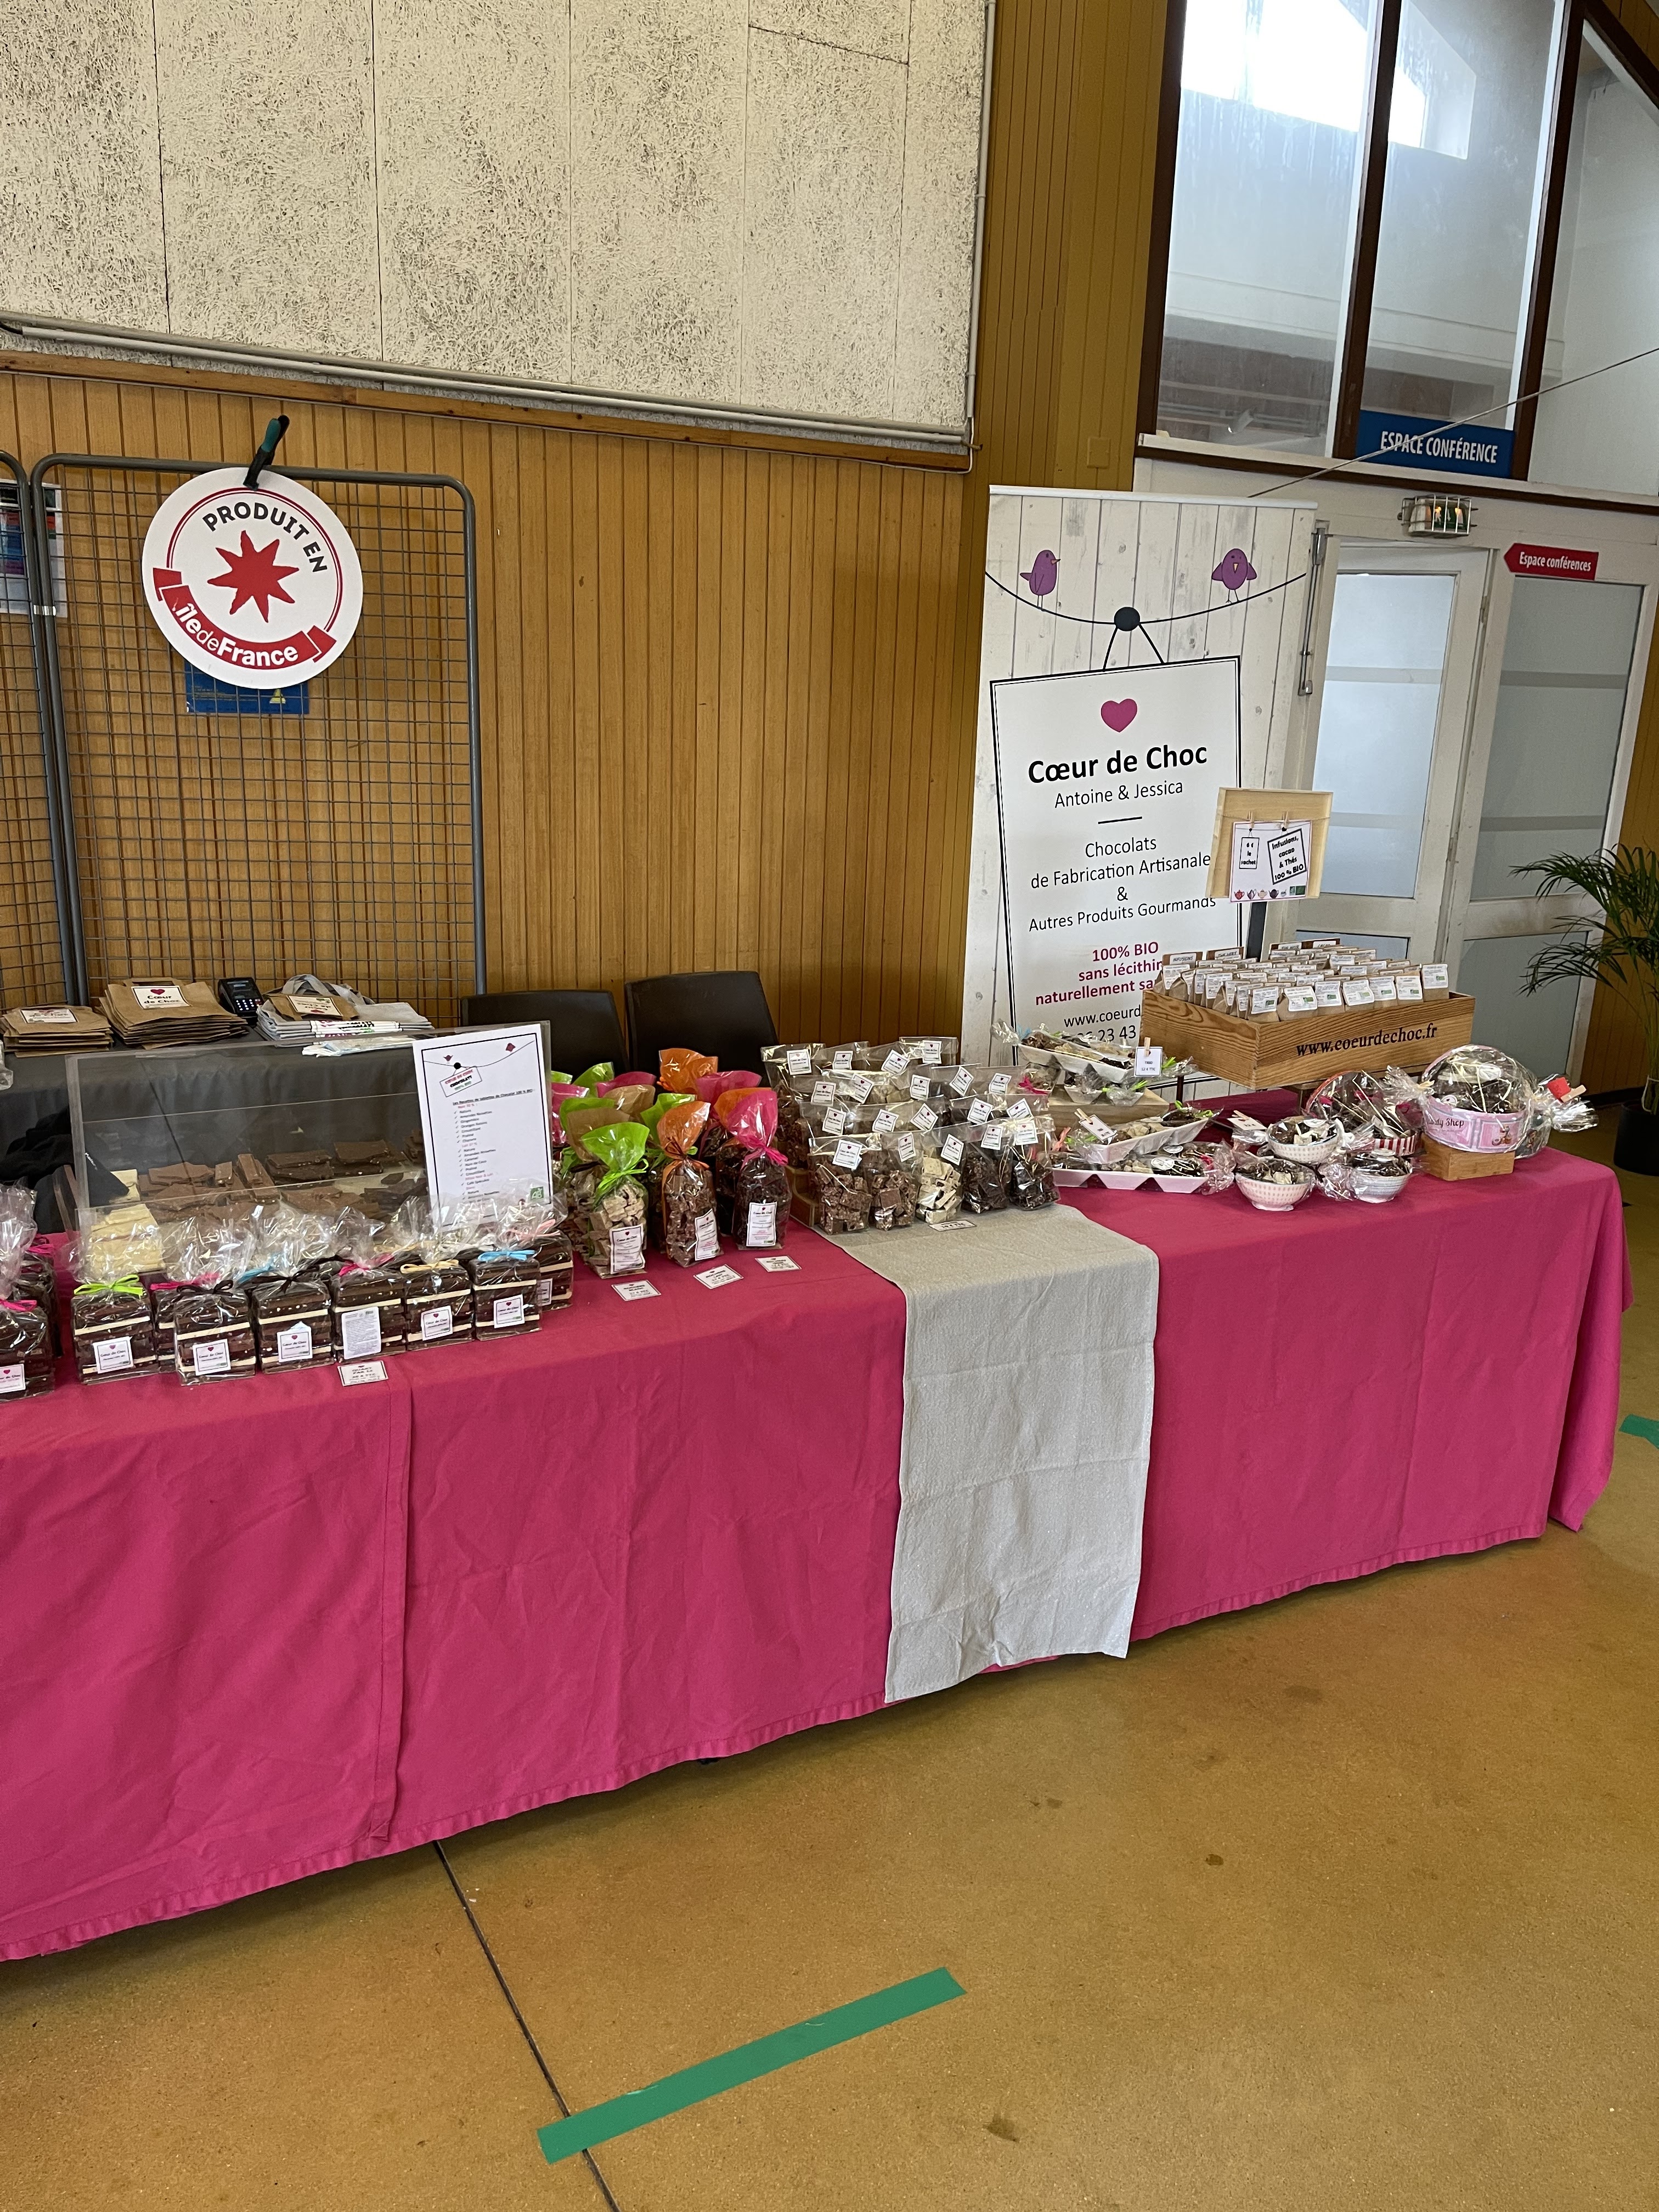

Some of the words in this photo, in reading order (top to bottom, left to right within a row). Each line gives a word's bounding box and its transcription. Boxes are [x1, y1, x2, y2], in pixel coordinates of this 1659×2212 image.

[1380, 431, 1424, 454] ESPACE
[1426, 438, 1498, 463] CONFÉRENCE
[202, 502, 309, 540] PRODUIT
[303, 541, 328, 572] EN
[1520, 552, 1545, 568] Espace
[1547, 556, 1591, 572] conférences
[1029, 759, 1098, 783] Cœur
[1107, 751, 1137, 774] de
[1147, 745, 1207, 769] Choc
[1055, 789, 1113, 809] Antoine
[1118, 785, 1129, 800] &
[1134, 780, 1183, 799] Jessica
[1085, 837, 1156, 857] Chocolats
[1279, 848, 1294, 857] cacao
[1031, 873, 1048, 889] de
[1054, 864, 1133, 885] Fabrication
[1139, 852, 1210, 874] Artisanale
[1285, 856, 1297, 866] Thés
[1275, 872, 1285, 881] 100
[1293, 864, 1304, 873] BIO
[1117, 887, 1128, 901] &
[1029, 916, 1073, 932] Autres
[1077, 906, 1133, 924] Produits
[1138, 898, 1216, 916] Gourmands
[1093, 945, 1130, 961] 100%
[1135, 942, 1159, 956] BIO
[1079, 968, 1109, 981] sans
[1114, 959, 1162, 976] lécithin
[1036, 981, 1135, 1005] naturellement
[1139, 980, 1153, 990] sa
[1064, 1005, 1141, 1027] www.coeurd
[1119, 1025, 1136, 1039] 43
[1296, 1023, 1437, 1056] www.coeurdechoc.fr
[1446, 1118, 1464, 1128] Shop
